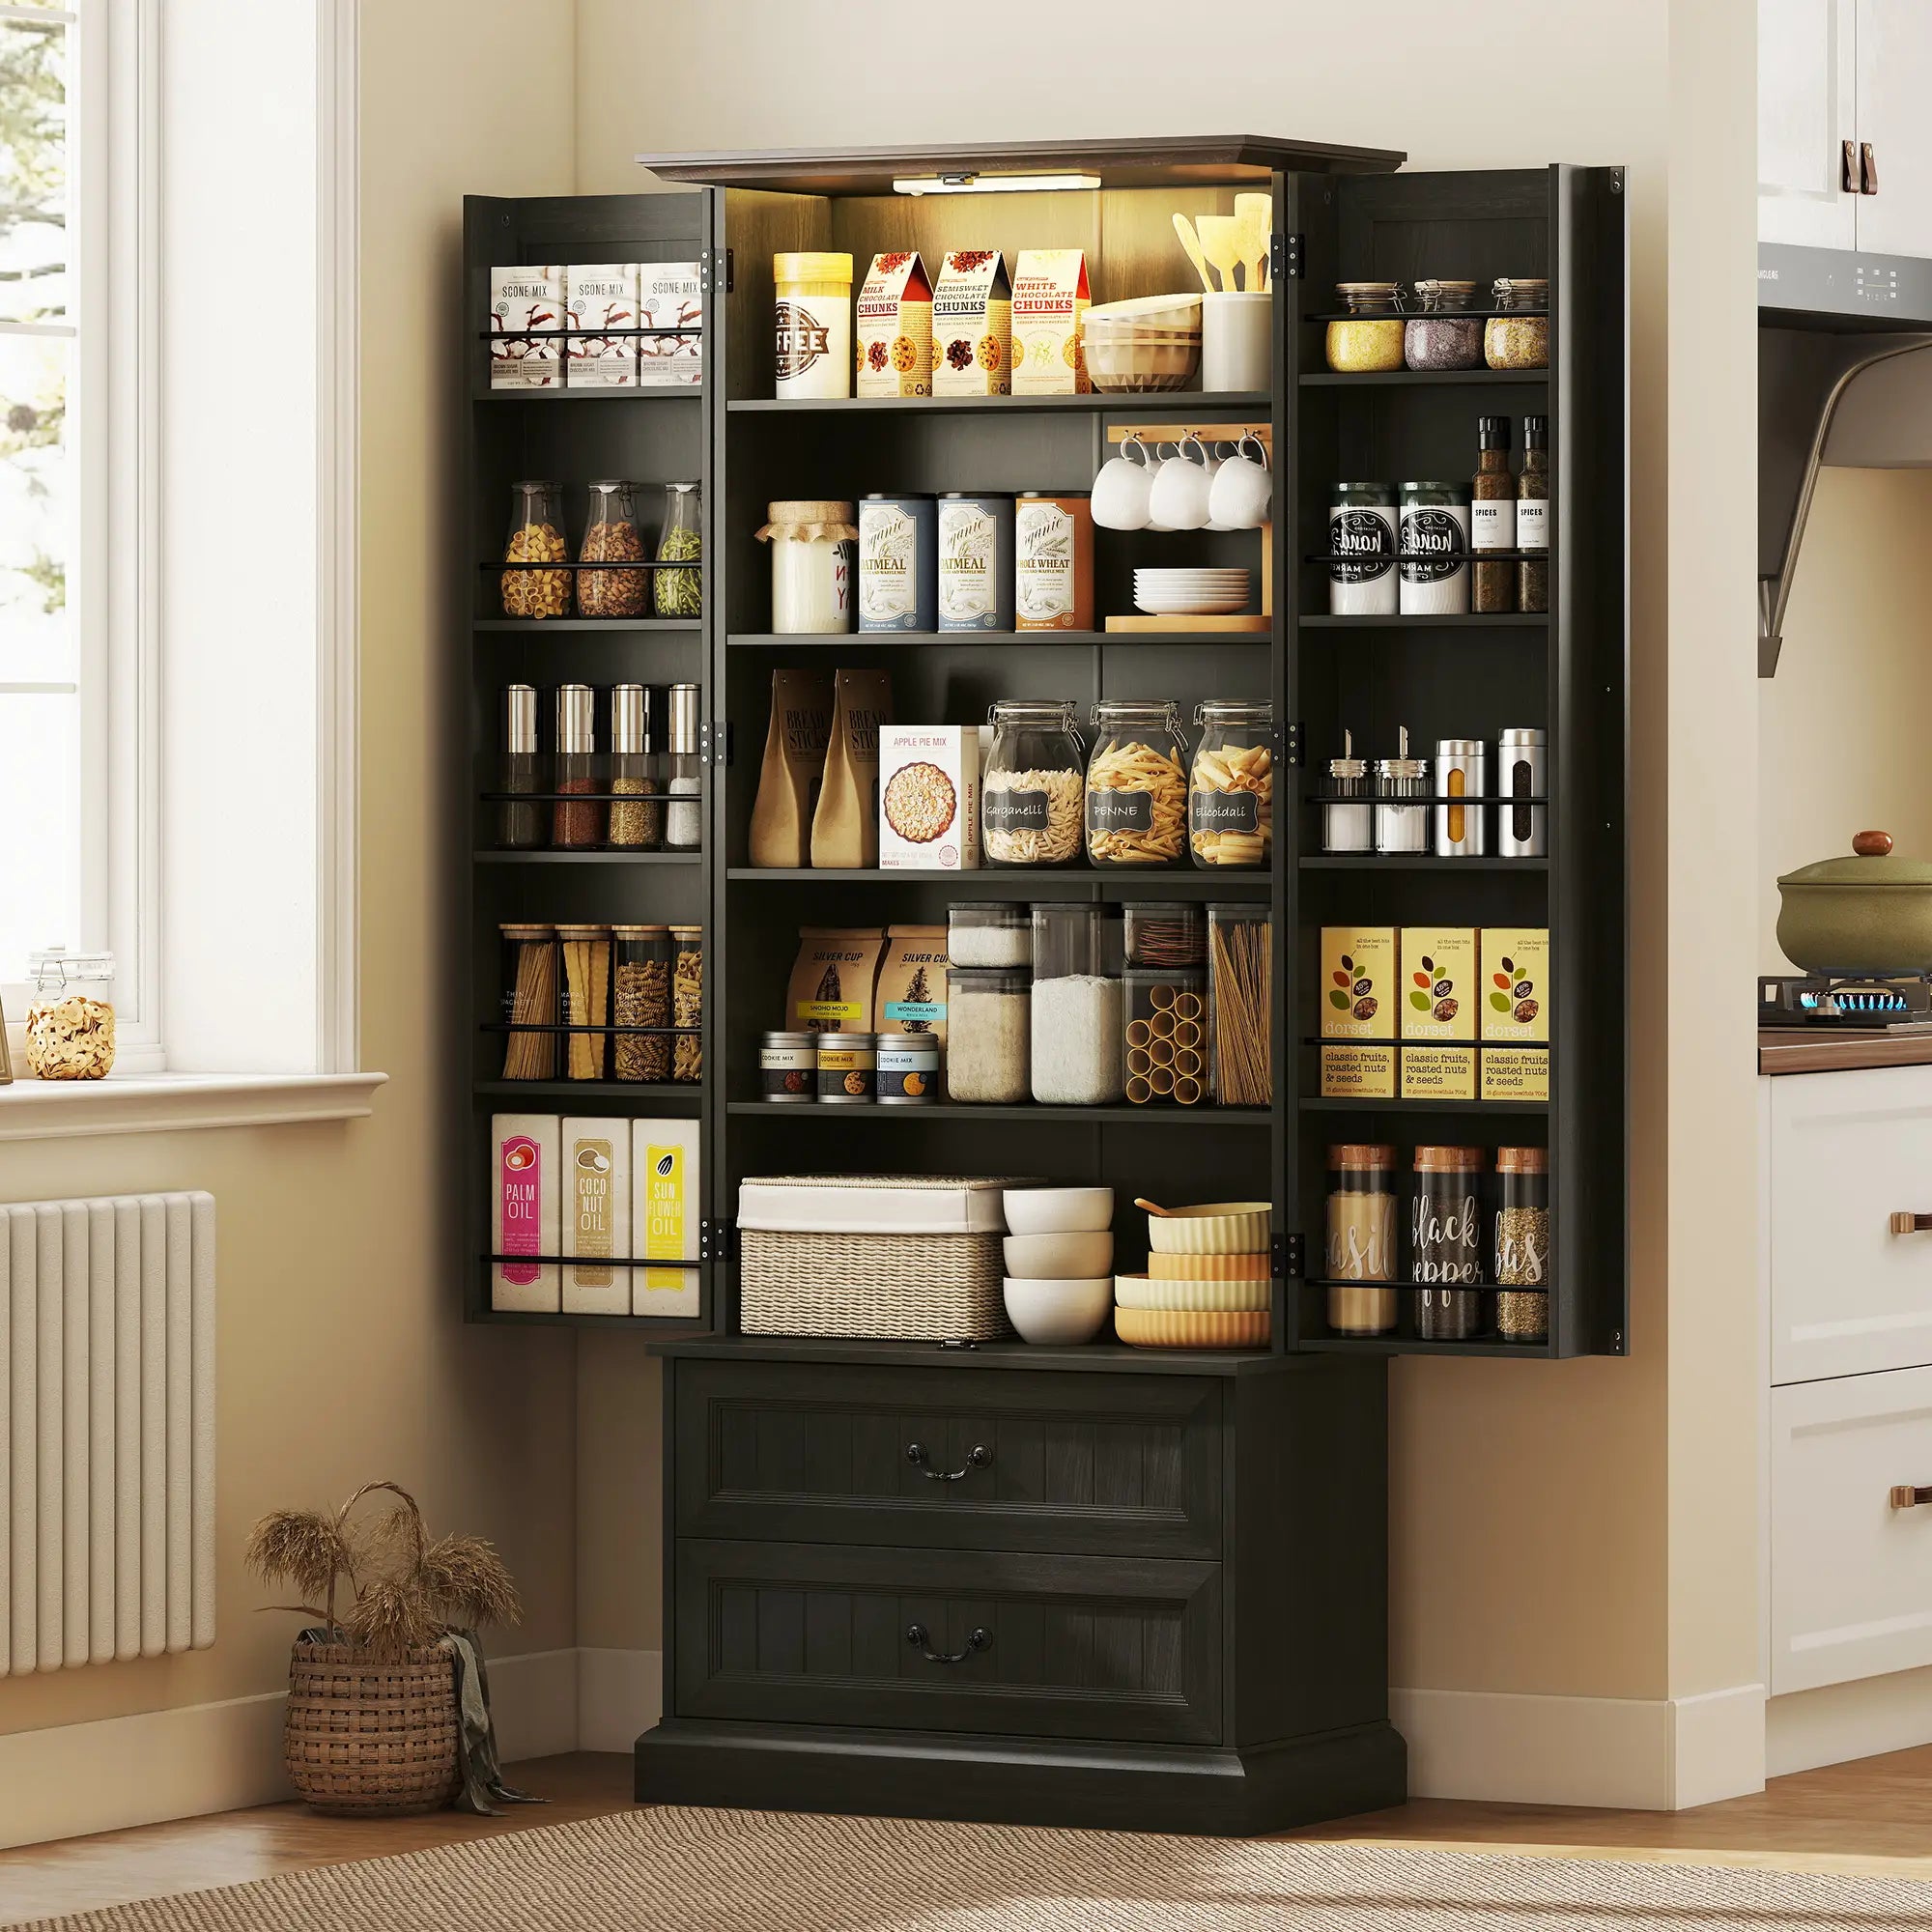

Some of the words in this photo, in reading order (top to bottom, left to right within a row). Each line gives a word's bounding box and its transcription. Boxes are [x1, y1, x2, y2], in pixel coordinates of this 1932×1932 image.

[502, 286, 529, 298] SCONE
[532, 286, 547, 297] MIX
[579, 284, 606, 296] SCONE
[609, 284, 624, 295] MIX
[652, 282, 679, 295] SCONE
[682, 282, 697, 293] MIX
[858, 302, 898, 314] CHUNKS
[934, 301, 985, 311] CHUNKS
[1013, 299, 1073, 310] CHUNKS
[1017, 559, 1037, 568] HOLE
[1037, 558, 1070, 568] WHEAT
[851, 729, 879, 750] STIC
[894, 737, 917, 746] APPLE
[919, 737, 931, 746] PIE
[932, 737, 947, 746] MIX
[986, 804, 1042, 818] Garganelli
[1094, 806, 1138, 816] PENNE
[1195, 806, 1246, 817] Elicoidali
[812, 952, 842, 961] SILVER
[844, 952, 864, 962] CUP
[901, 952, 932, 962] SILVER
[1325, 1021, 1374, 1036] dorset
[1406, 1021, 1455, 1036] dorset
[1485, 1023, 1535, 1037] dorset
[1325, 1052, 1358, 1062] classic
[1359, 1053, 1390, 1063] fruits,
[1406, 1054, 1438, 1063] classic
[1440, 1054, 1470, 1064] fruits,
[1486, 1055, 1519, 1064] classic
[1325, 1064, 1362, 1072] roasted
[1364, 1065, 1387, 1073] nuts
[1406, 1065, 1442, 1073] roasted
[1444, 1065, 1467, 1074] nuts
[1486, 1066, 1522, 1075] roasted
[1325, 1073, 1335, 1083] &
[1336, 1074, 1363, 1083] seeds
[1406, 1075, 1414, 1084] &
[1416, 1076, 1443, 1085] seeds
[1486, 1076, 1494, 1085] &
[1496, 1077, 1523, 1086] seeds
[506, 1183, 535, 1201] PALM
[579, 1178, 607, 1195] COCO
[654, 1181, 675, 1200] SUN
[582, 1196, 604, 1212] NUT
[648, 1200, 681, 1217] FLOWER
[507, 1202, 533, 1219] OIL
[581, 1213, 606, 1231] OIL
[652, 1218, 677, 1236] OIL
[1411, 1194, 1480, 1250] black
[1326, 1201, 1394, 1280] asil
[1494, 1210, 1548, 1283] bas
